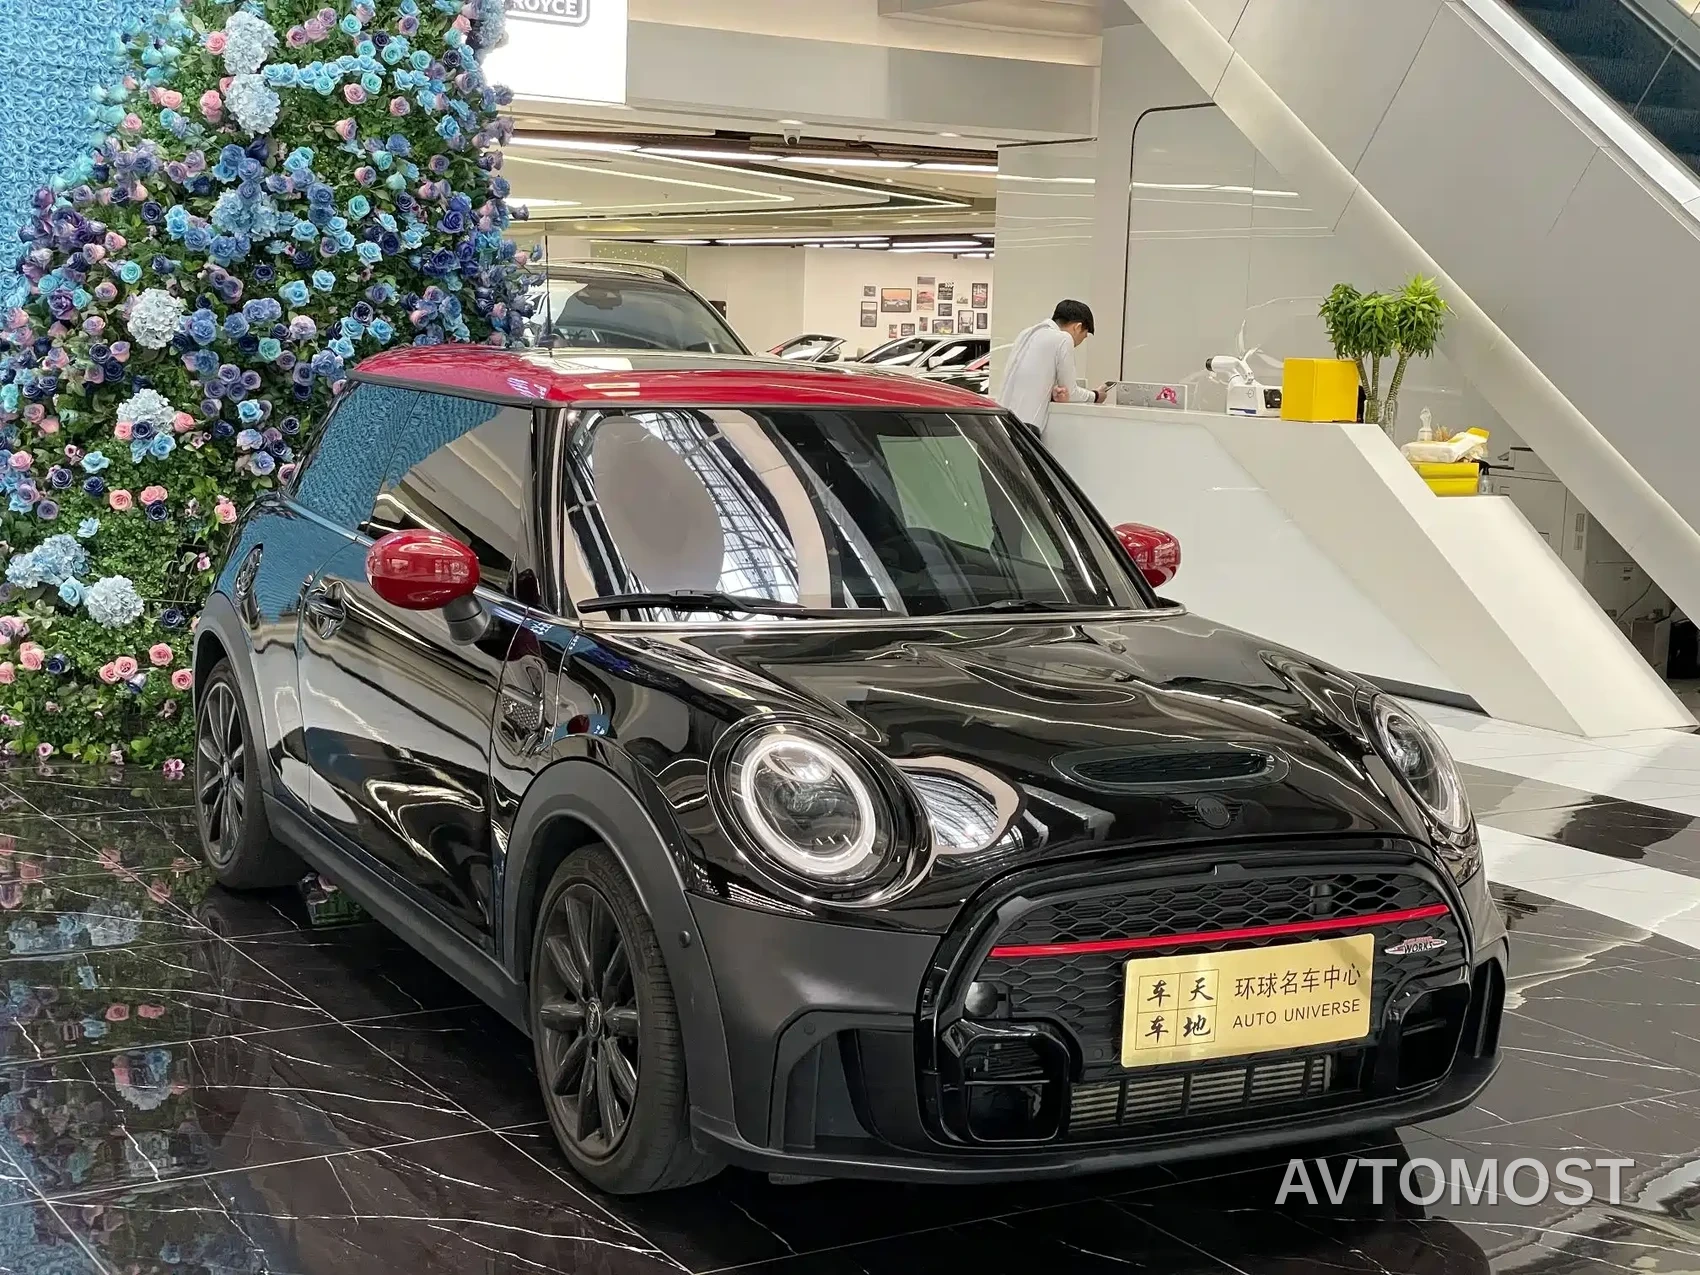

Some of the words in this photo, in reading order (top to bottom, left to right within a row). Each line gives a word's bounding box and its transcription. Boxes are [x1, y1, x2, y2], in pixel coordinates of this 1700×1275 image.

[1404, 942, 1433, 954] WORKS
[1234, 963, 1361, 1001] 环球名车中心
[1232, 1011, 1277, 1029] AUTO
[1284, 998, 1361, 1022] UNIVERSE
